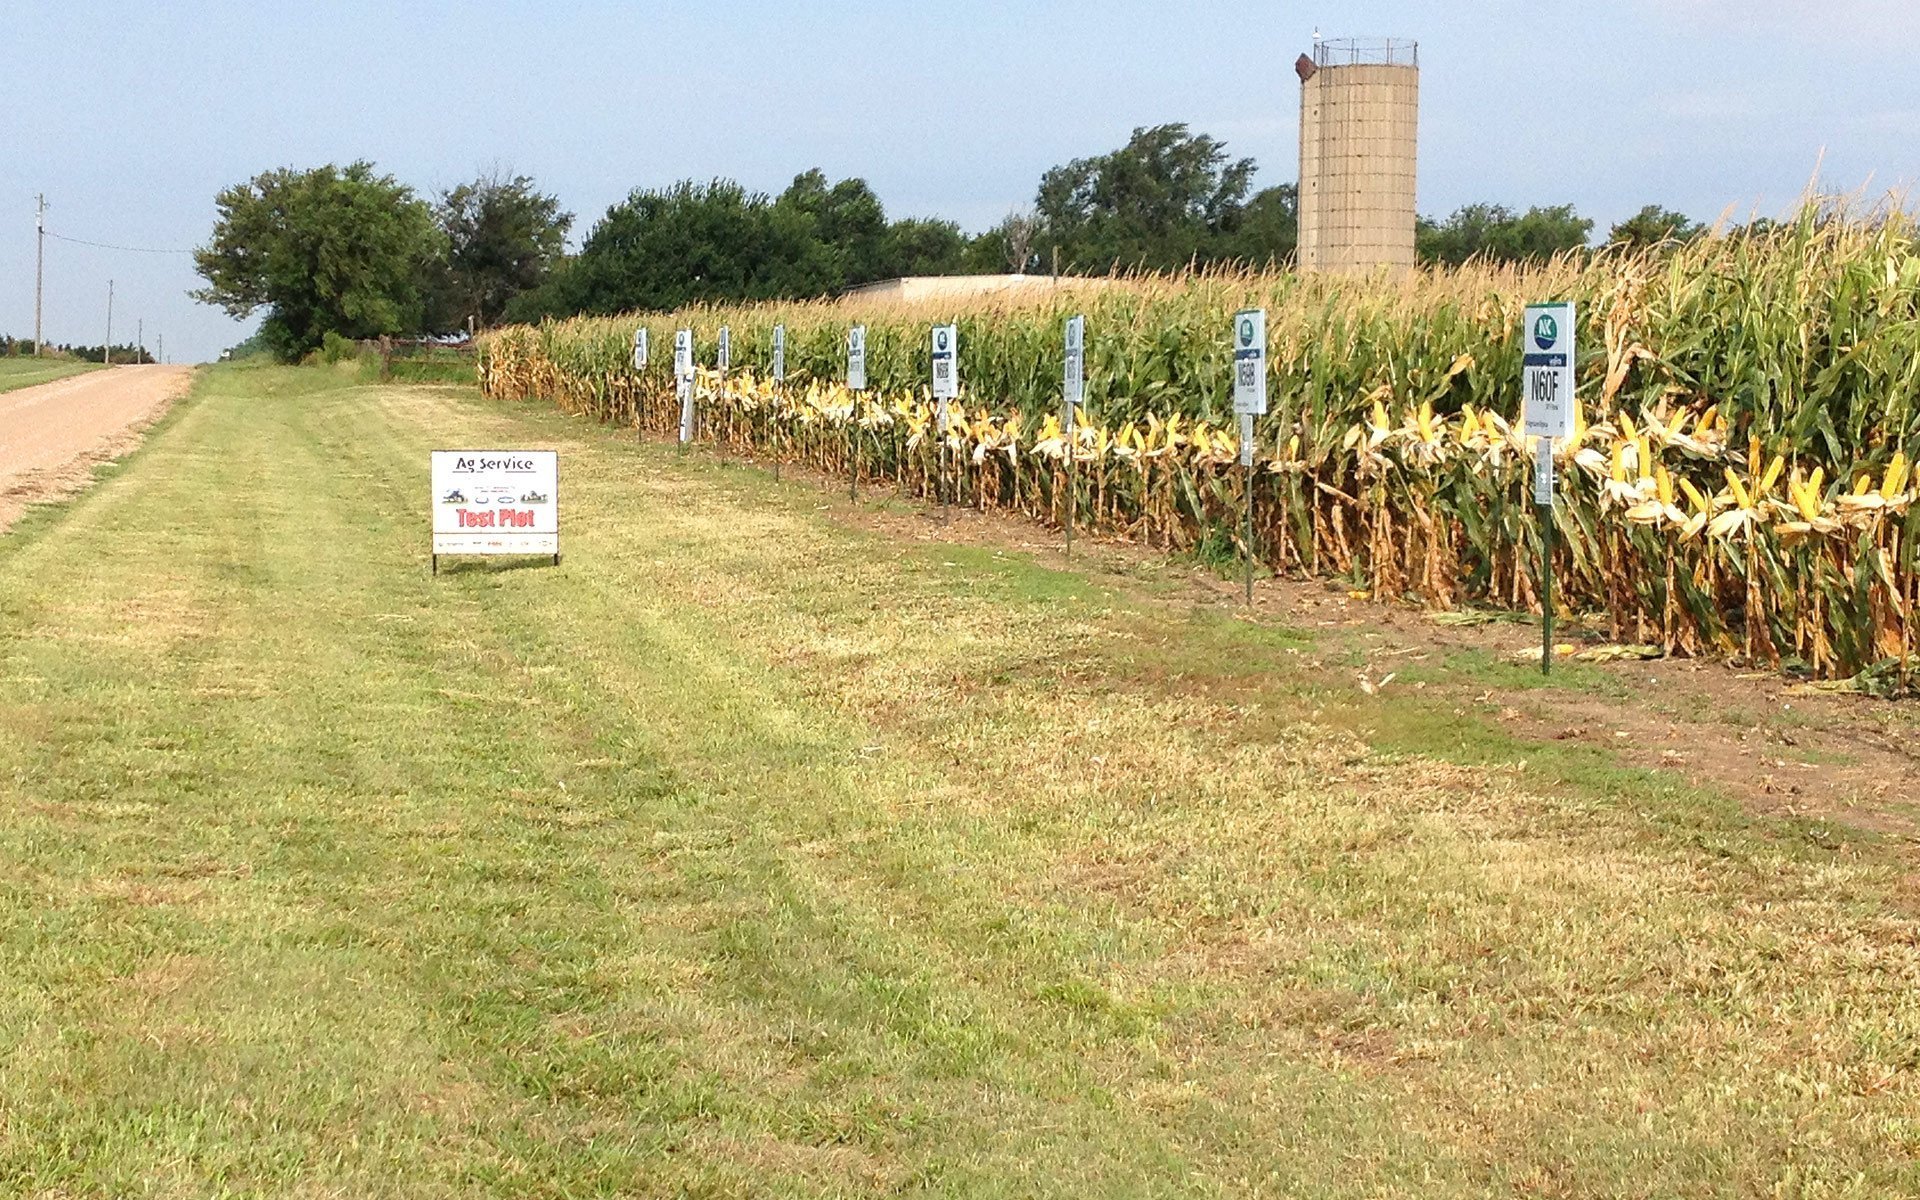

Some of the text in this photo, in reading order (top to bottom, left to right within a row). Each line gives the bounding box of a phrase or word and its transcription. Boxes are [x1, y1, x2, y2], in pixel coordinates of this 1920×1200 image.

[1538, 318, 1552, 336] NK
[1531, 370, 1558, 401] N60F
[456, 456, 534, 473] Ag Service
[456, 508, 535, 527] Test Plot
